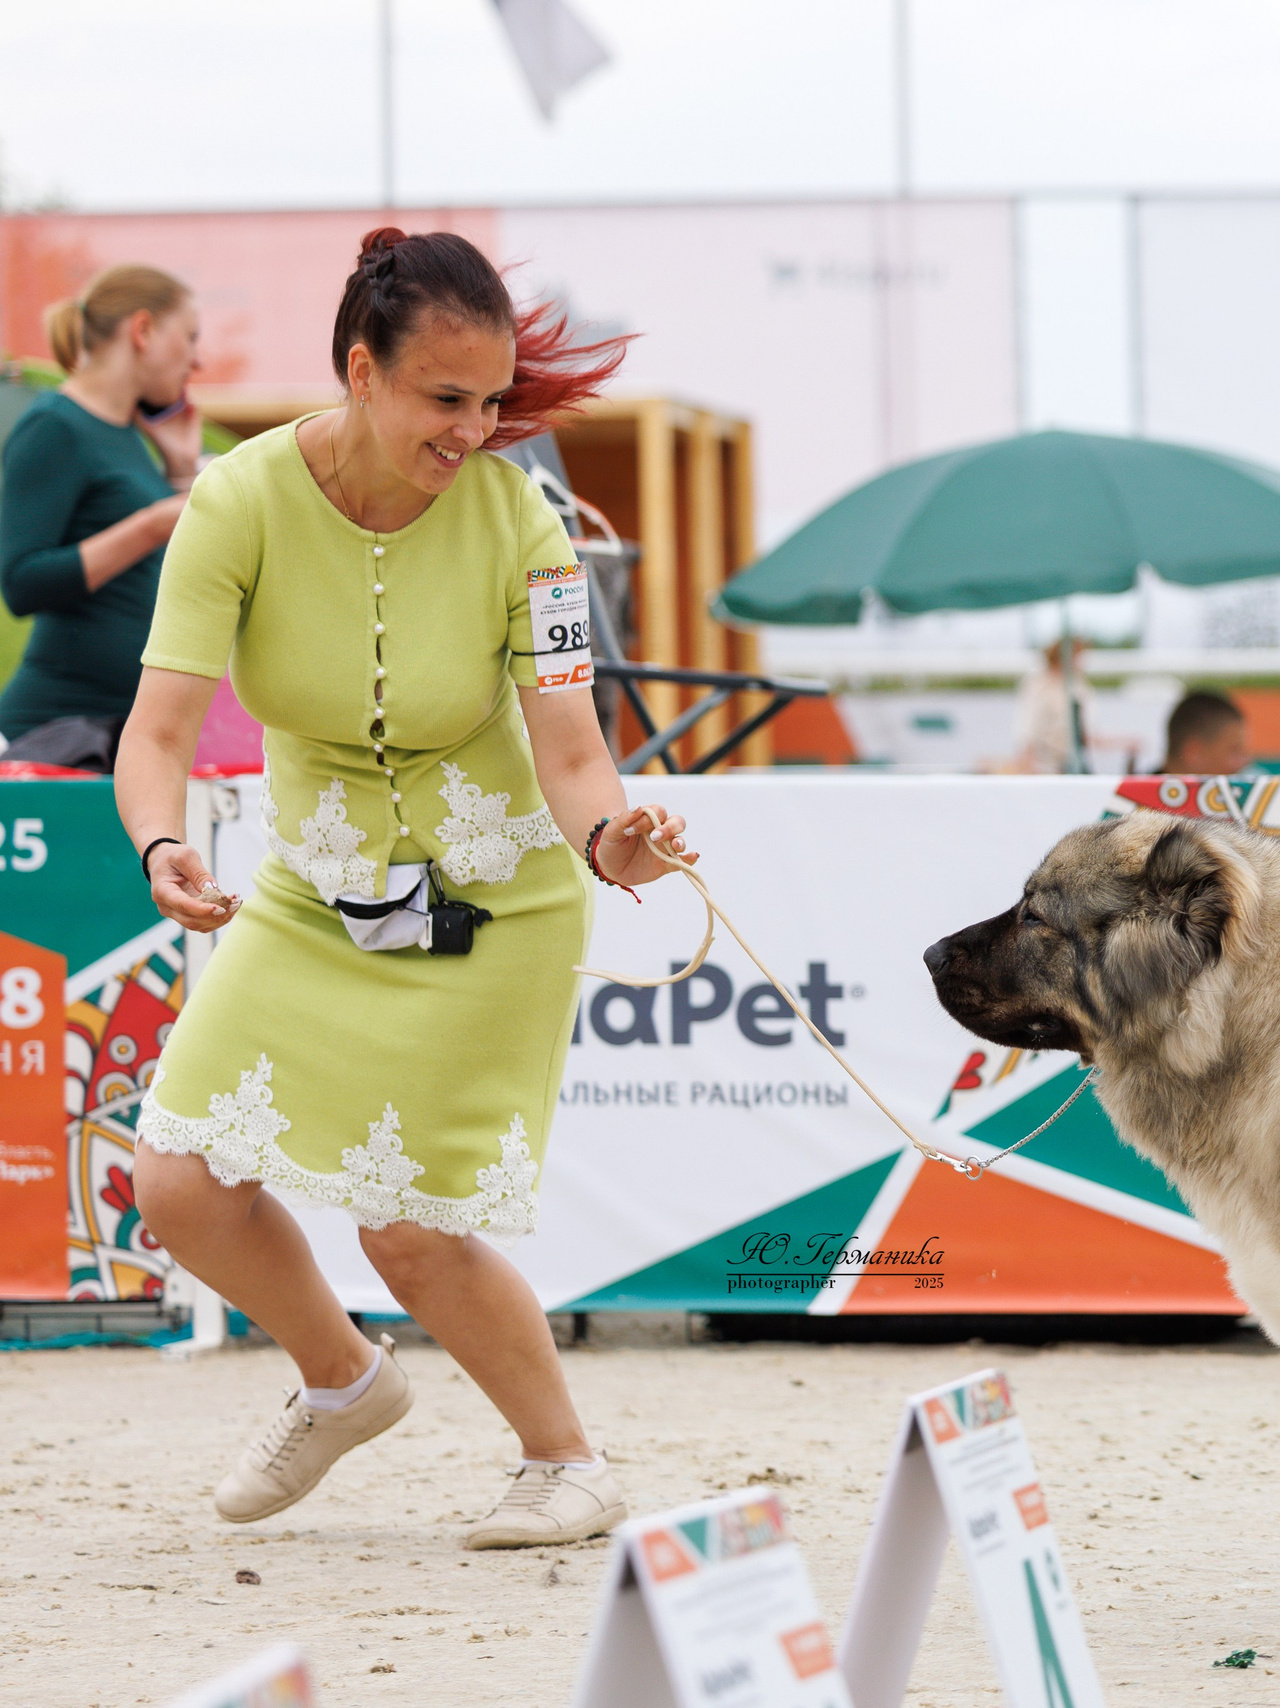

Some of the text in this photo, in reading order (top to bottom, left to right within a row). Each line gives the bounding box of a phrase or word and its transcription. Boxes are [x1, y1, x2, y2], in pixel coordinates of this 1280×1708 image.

[0, 817, 48, 873] 5
[571, 960, 846, 1046] aPet
[691, 1081, 848, 1112] РАЦИОНЫ
